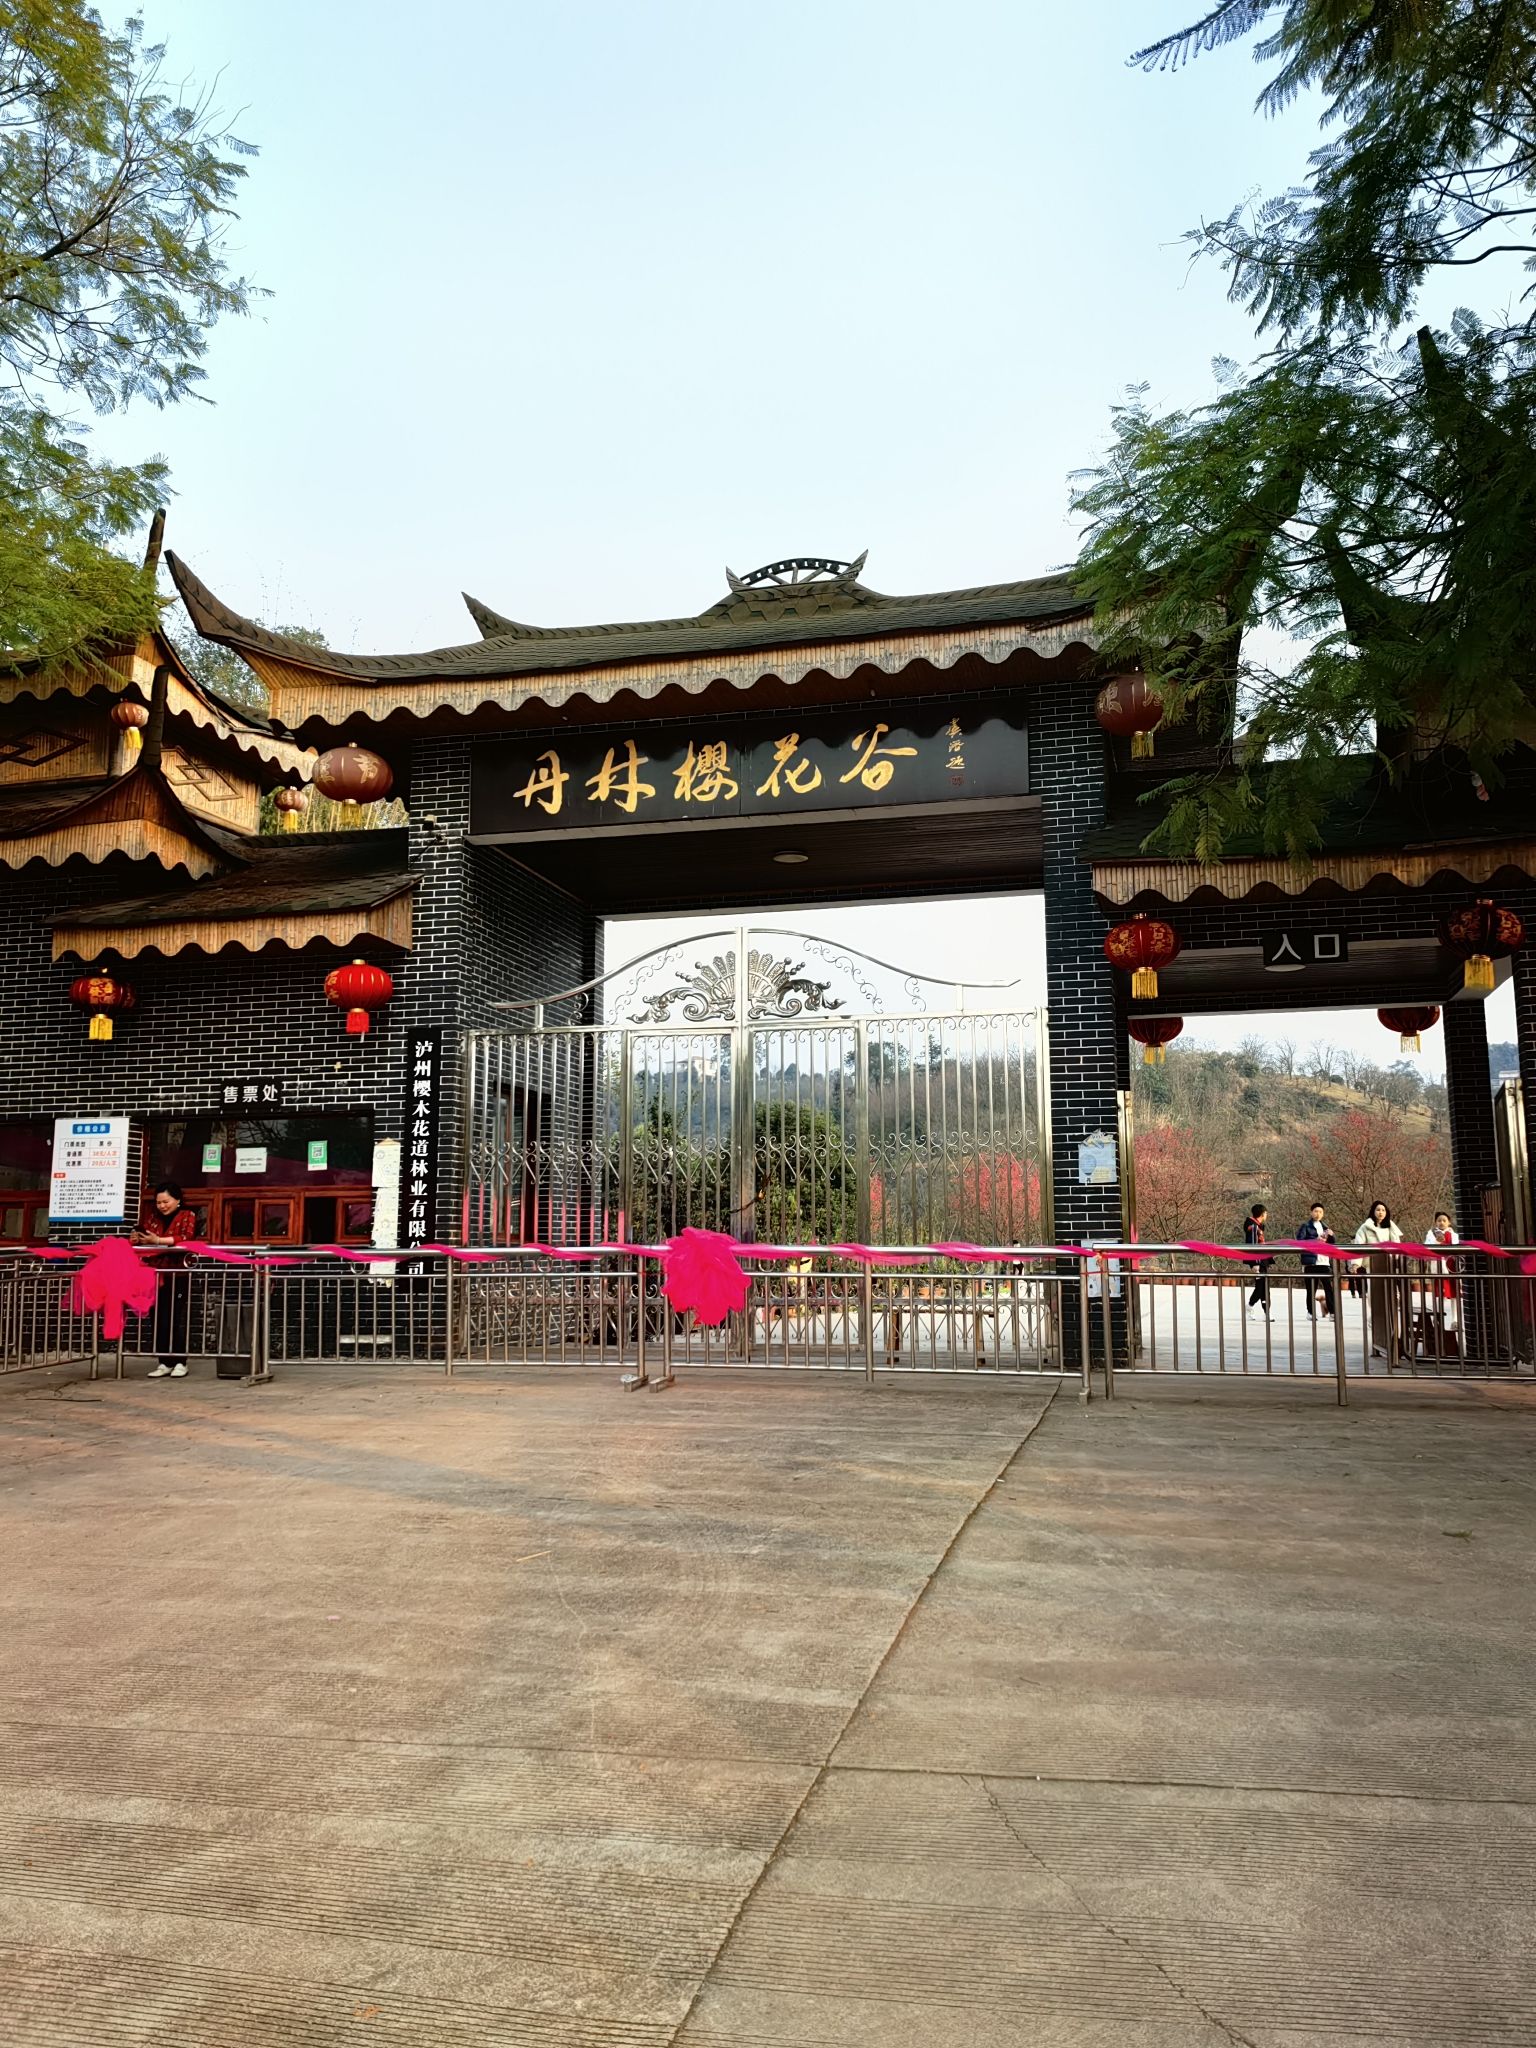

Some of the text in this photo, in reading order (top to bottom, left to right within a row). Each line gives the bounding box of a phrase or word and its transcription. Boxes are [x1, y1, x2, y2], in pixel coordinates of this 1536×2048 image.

[1271, 934, 1340, 961] 入口
[223, 1084, 278, 1103] 售票处
